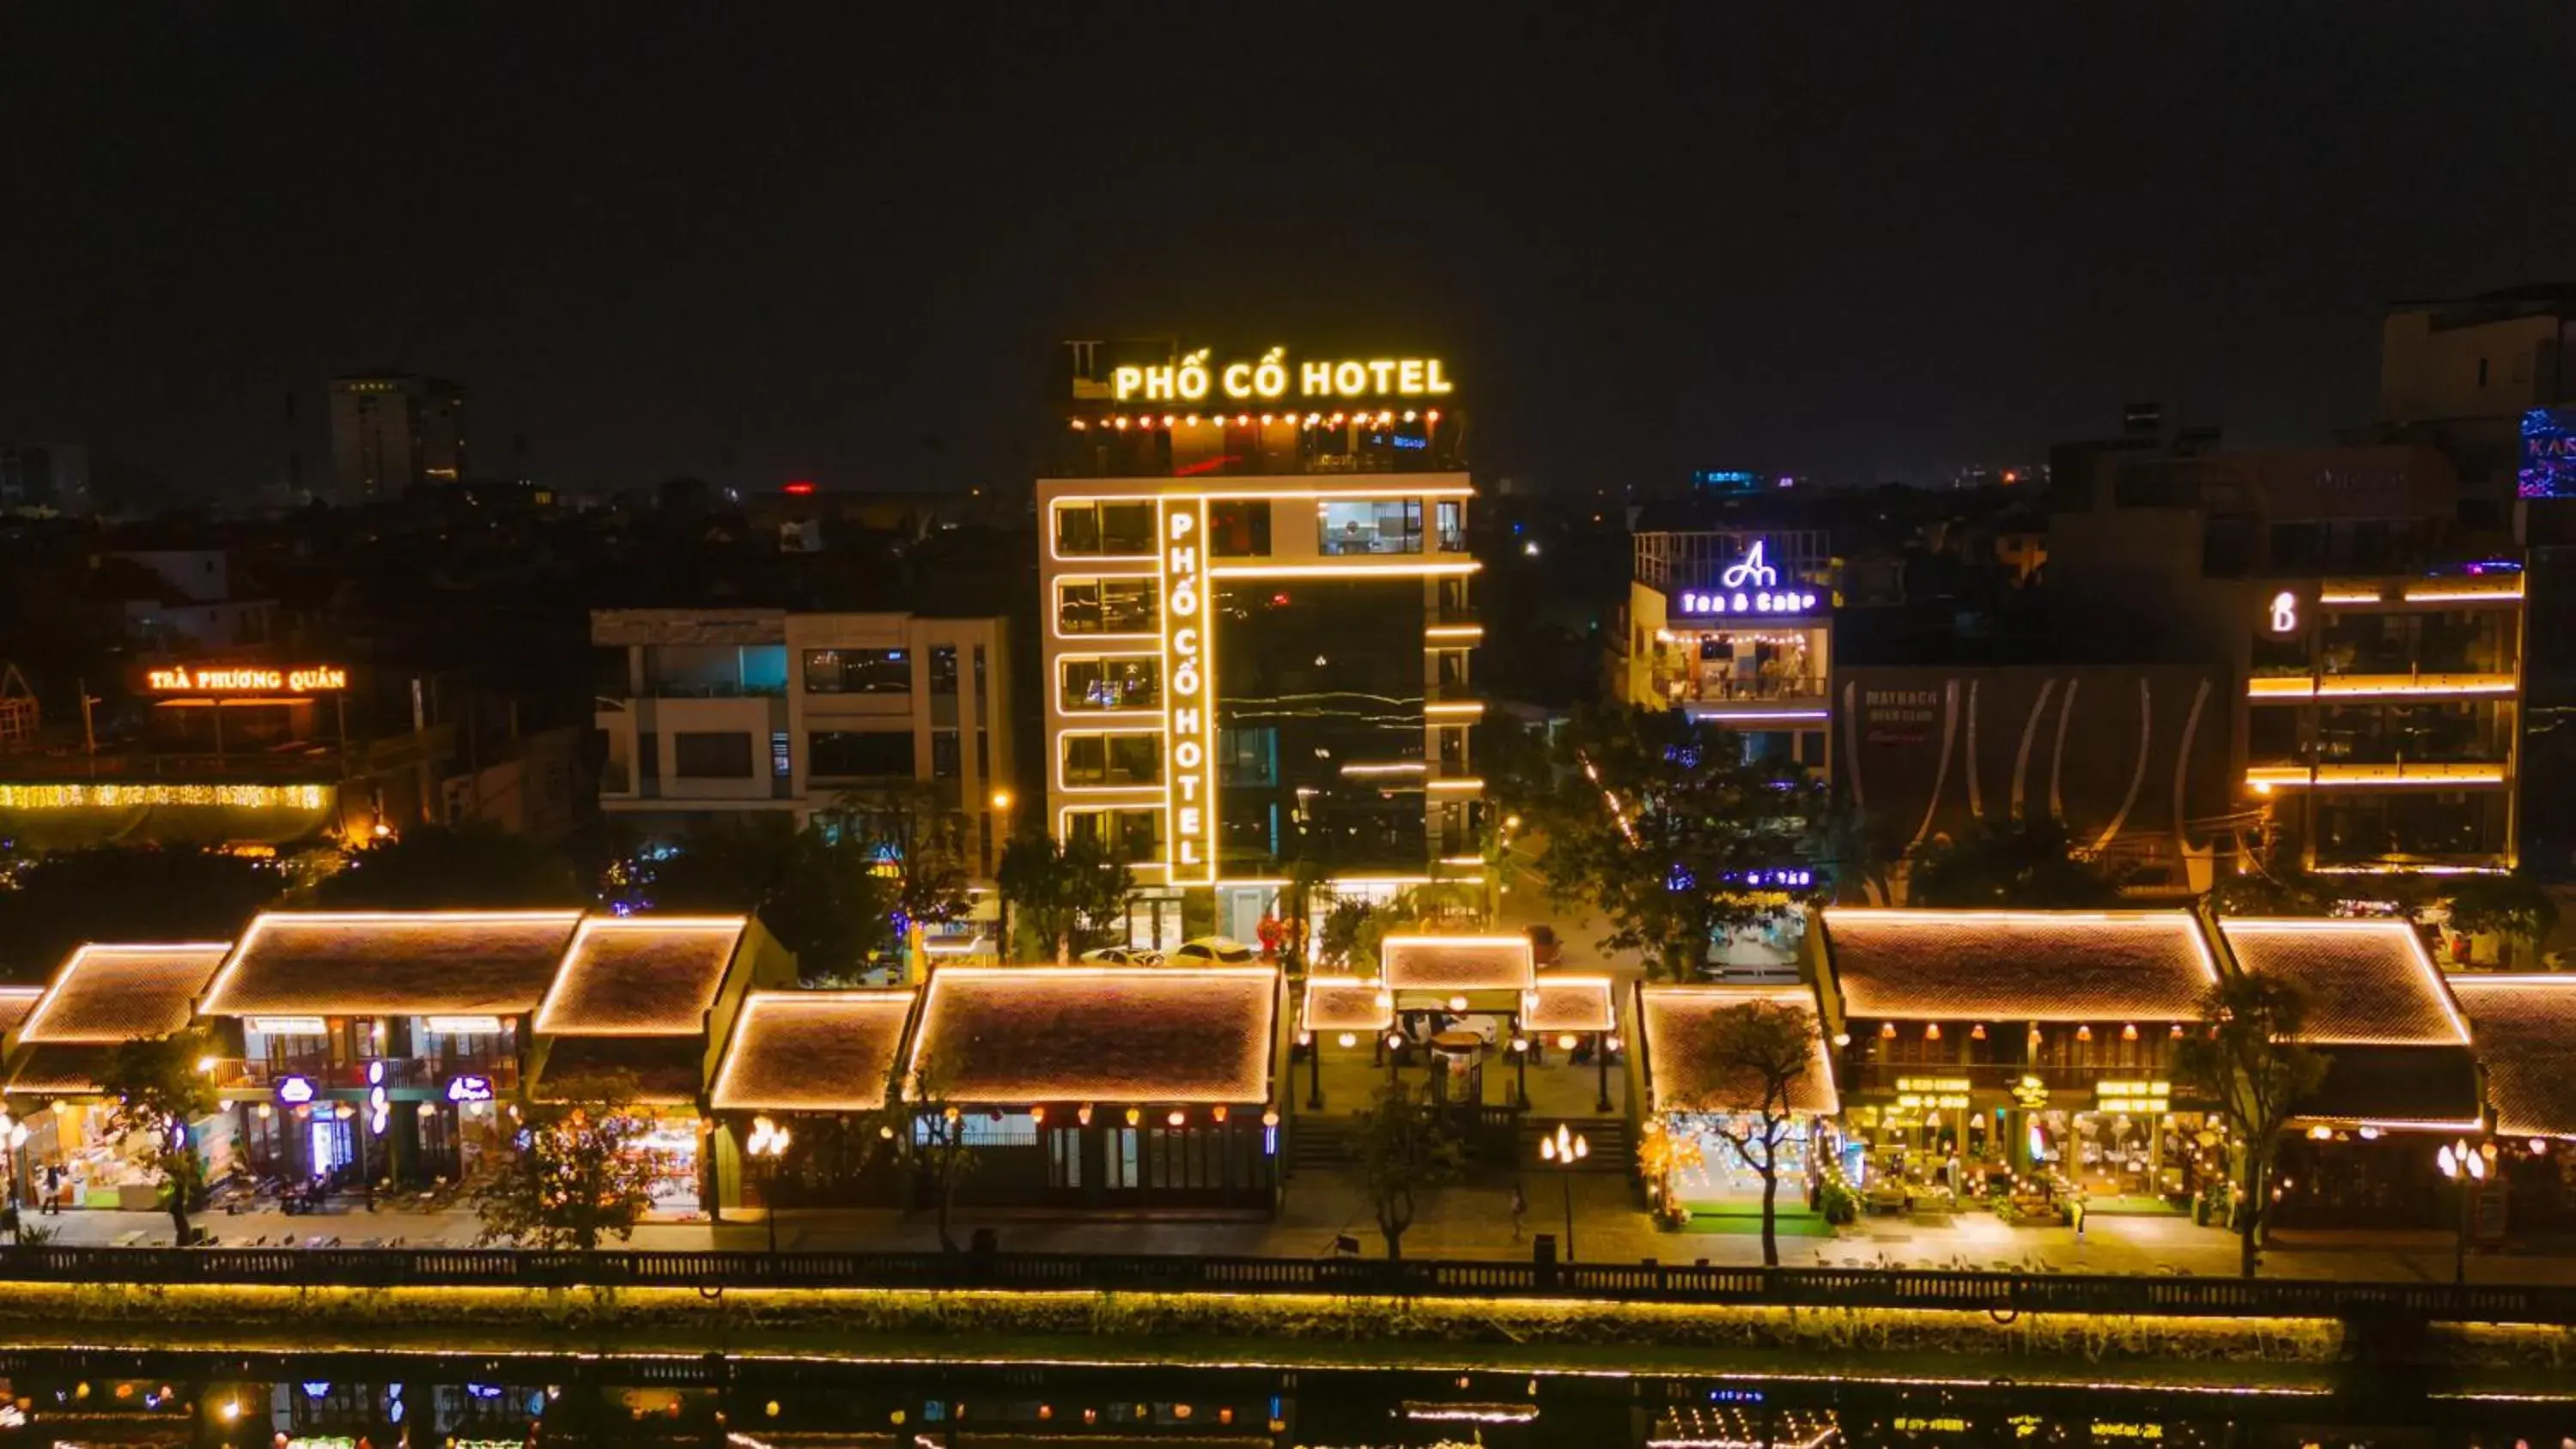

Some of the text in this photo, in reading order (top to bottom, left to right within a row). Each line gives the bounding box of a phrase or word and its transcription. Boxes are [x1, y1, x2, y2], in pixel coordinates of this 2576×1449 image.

[1115, 347, 1452, 400] PHỐ CỔ HOTEL
[150, 665, 345, 691] TRÀ PHƯƠNG QUÁN
[1170, 512, 1201, 865] PHỐ CỔ HOTEL
